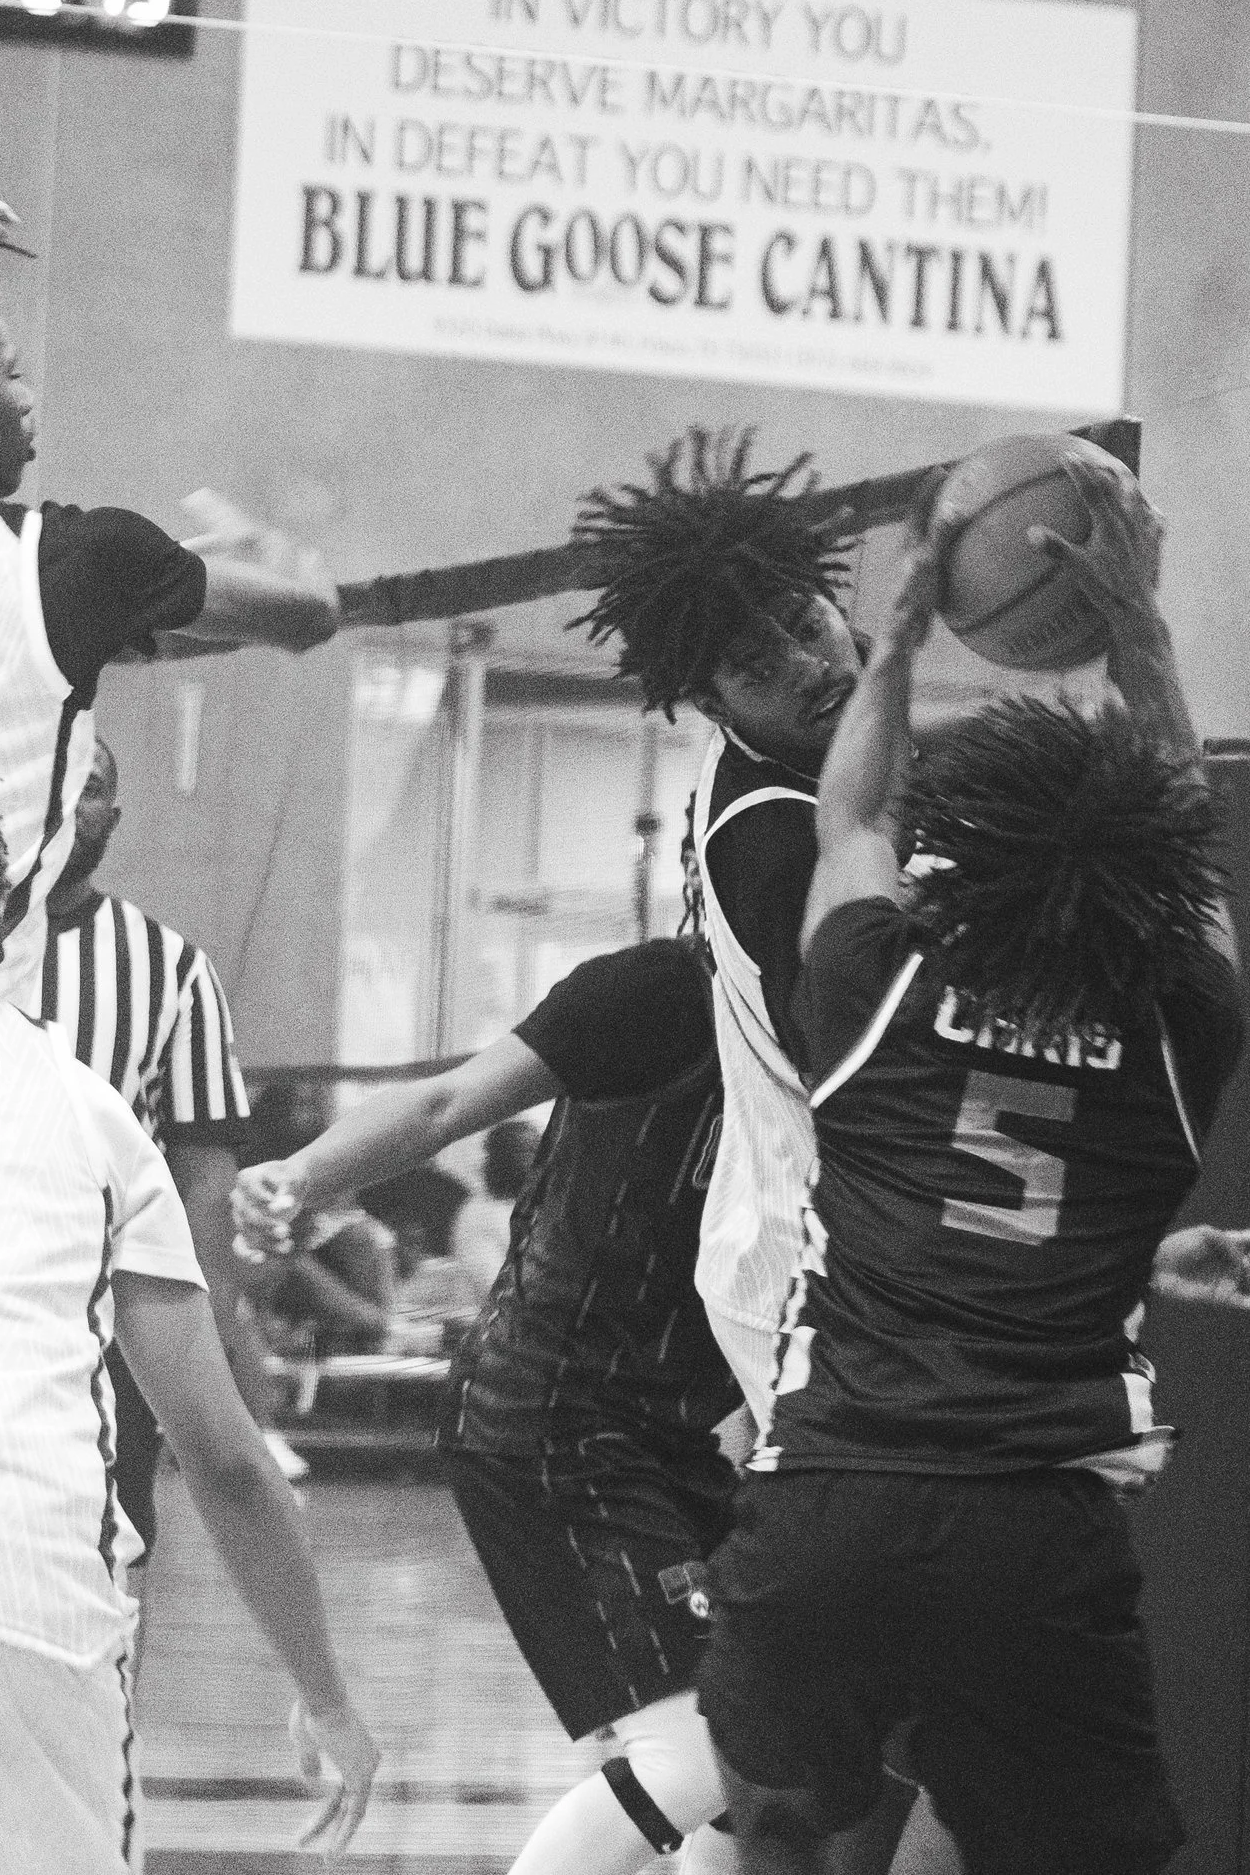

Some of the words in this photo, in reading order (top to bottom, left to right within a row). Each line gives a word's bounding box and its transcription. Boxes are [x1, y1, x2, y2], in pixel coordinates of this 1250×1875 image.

[803, 1, 909, 68] YOU
[390, 43, 627, 117] DESERVE
[643, 68, 994, 154] MARGARITAS.
[322, 109, 377, 168] IN
[394, 115, 602, 188] DEFEAT
[616, 137, 726, 204] YOU
[738, 151, 878, 219] NEED
[896, 165, 1051, 236] THEM!
[298, 180, 492, 292] BLUE
[507, 200, 736, 312] GOOSE
[758, 226, 1066, 346] CANTINA
[940, 1068, 1079, 1248] 5
